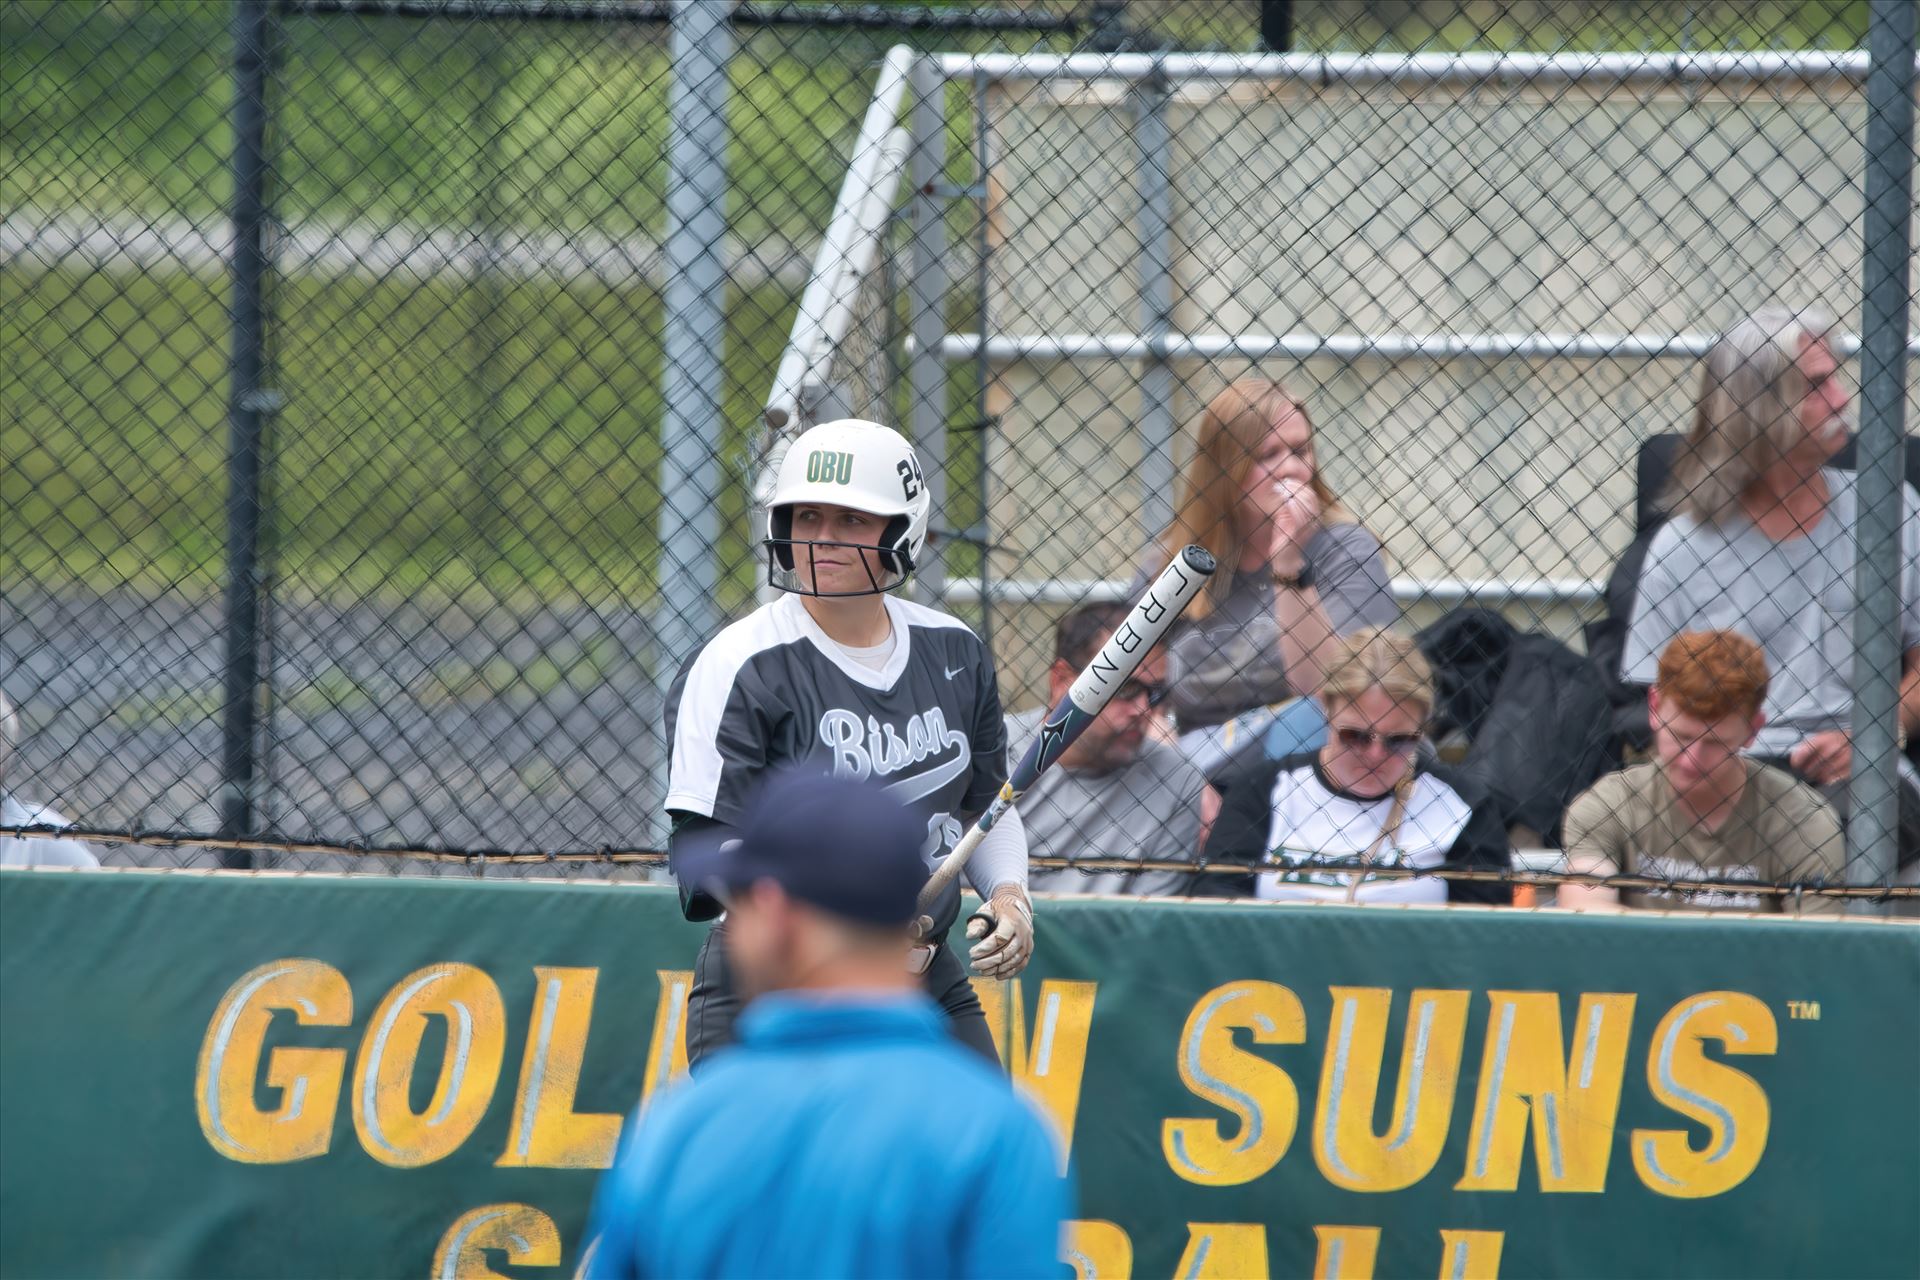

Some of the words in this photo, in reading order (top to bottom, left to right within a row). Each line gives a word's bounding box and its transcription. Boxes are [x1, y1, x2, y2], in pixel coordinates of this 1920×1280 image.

[806, 450, 854, 485] OBU
[896, 453, 924, 502] 24
[1091, 564, 1188, 685] CRBN
[819, 706, 968, 785] Bison
[1162, 979, 1779, 1199] SUNS
